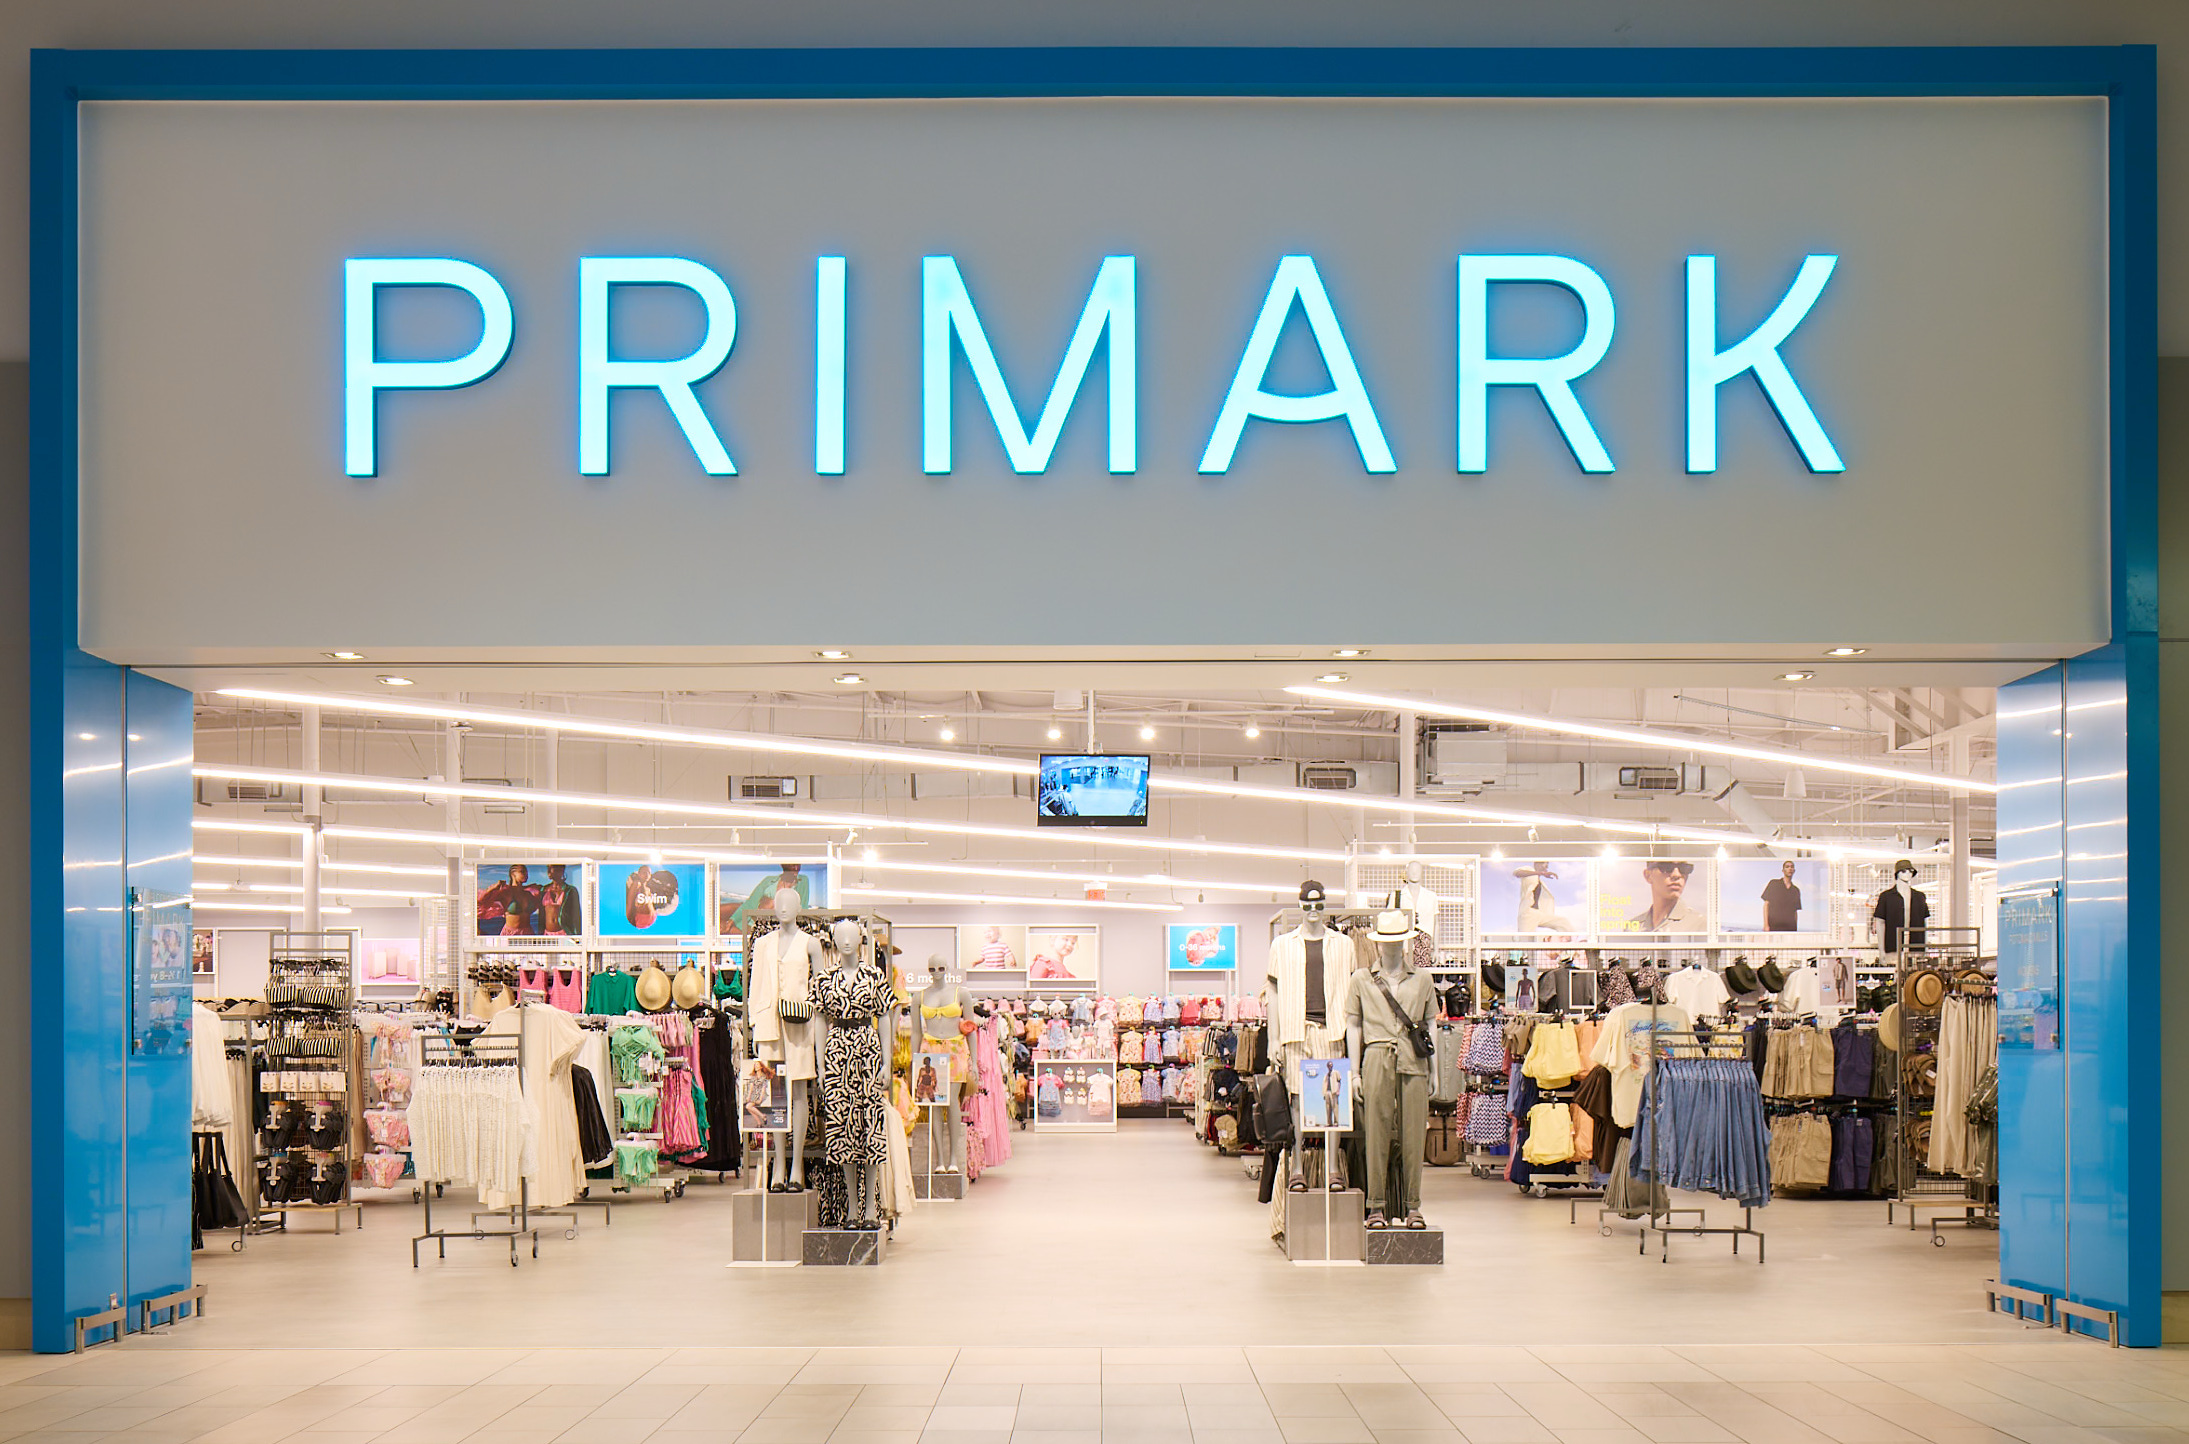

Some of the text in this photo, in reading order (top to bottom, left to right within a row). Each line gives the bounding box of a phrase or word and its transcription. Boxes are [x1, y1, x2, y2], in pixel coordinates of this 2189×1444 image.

[344, 254, 1846, 476] PRIMARK
[637, 892, 668, 904] Swim
[1599, 893, 1632, 905] Float
[1599, 906, 1624, 917] into
[1599, 917, 1640, 932] spring
[1179, 943, 1198, 951] 0-36
[918, 972, 962, 984] moths
